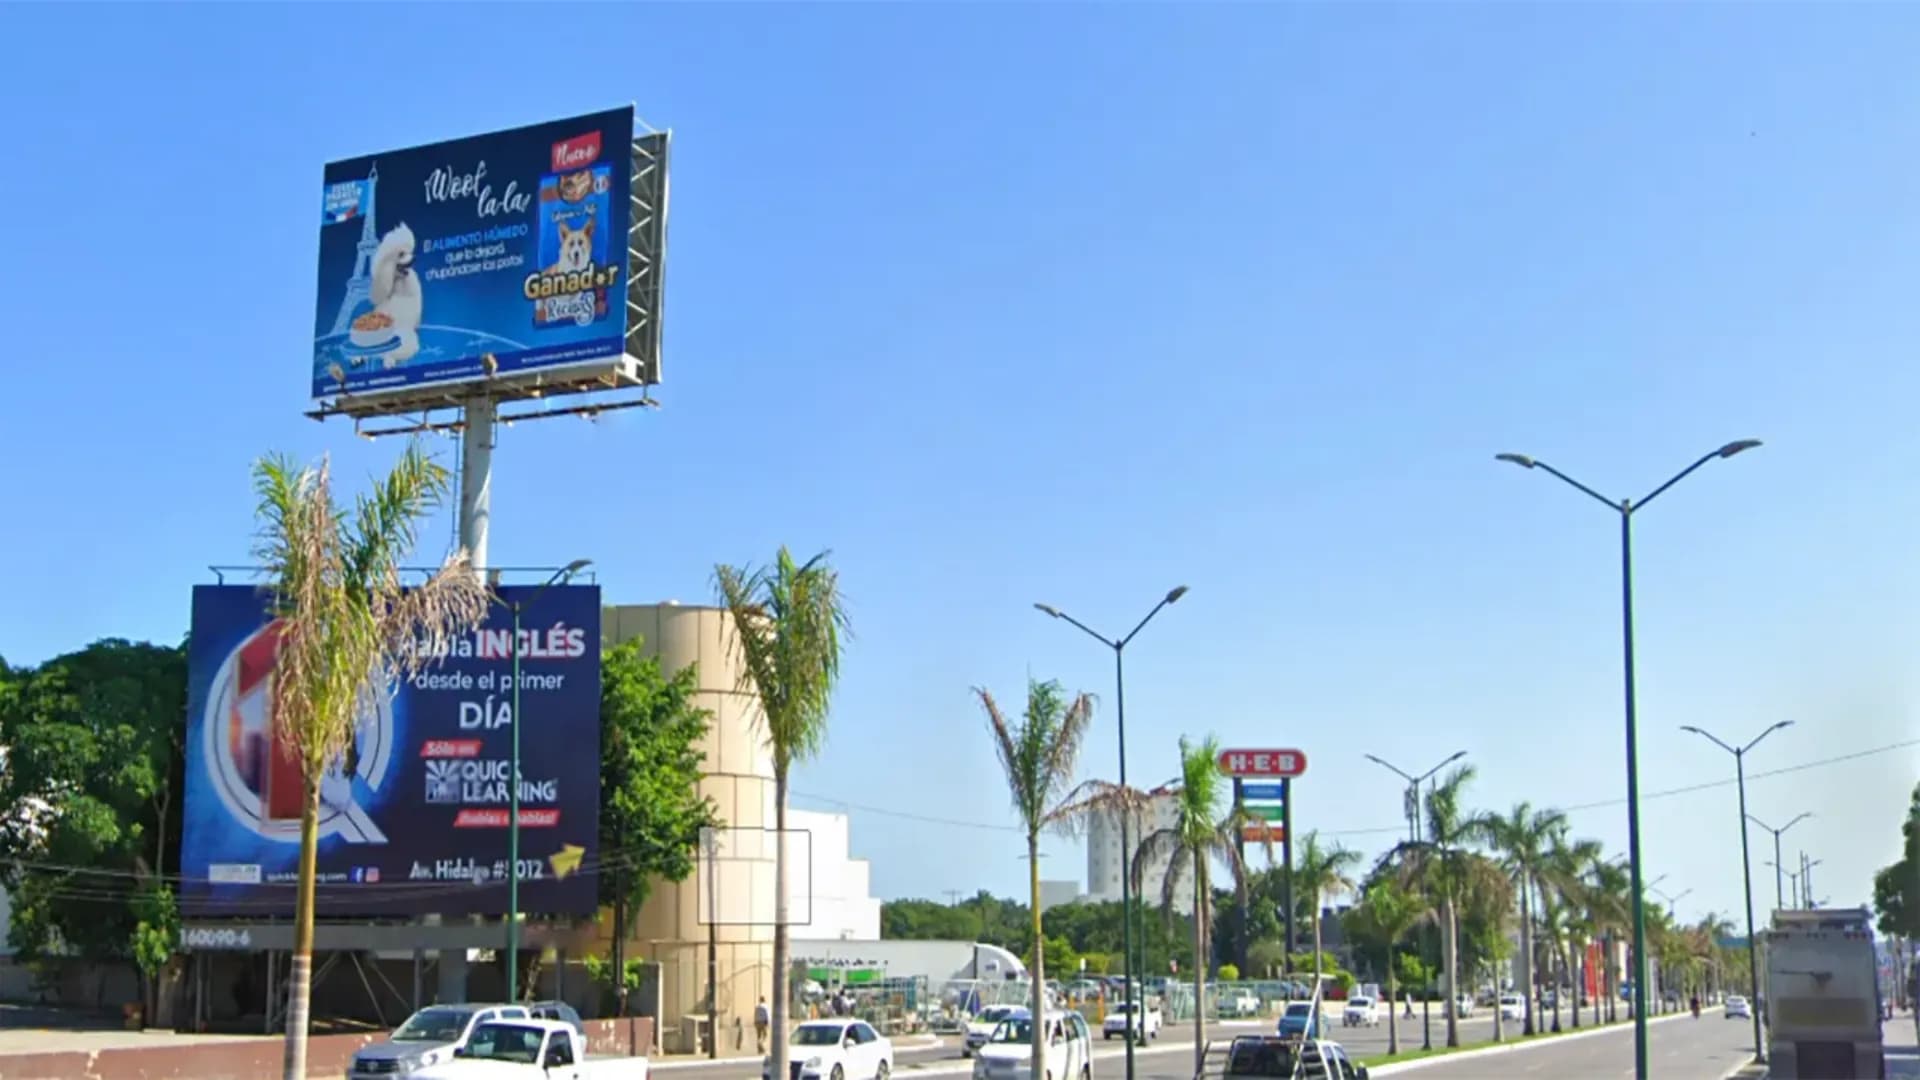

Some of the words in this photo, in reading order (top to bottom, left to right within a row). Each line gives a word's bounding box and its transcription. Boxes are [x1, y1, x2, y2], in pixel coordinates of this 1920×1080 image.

[432, 230, 481, 251] ALIMENTO
[475, 620, 586, 658] INGLÉS
[415, 670, 473, 689] desde
[478, 670, 495, 689] el
[501, 670, 564, 694] pimer
[436, 858, 490, 886] Hidalgo
